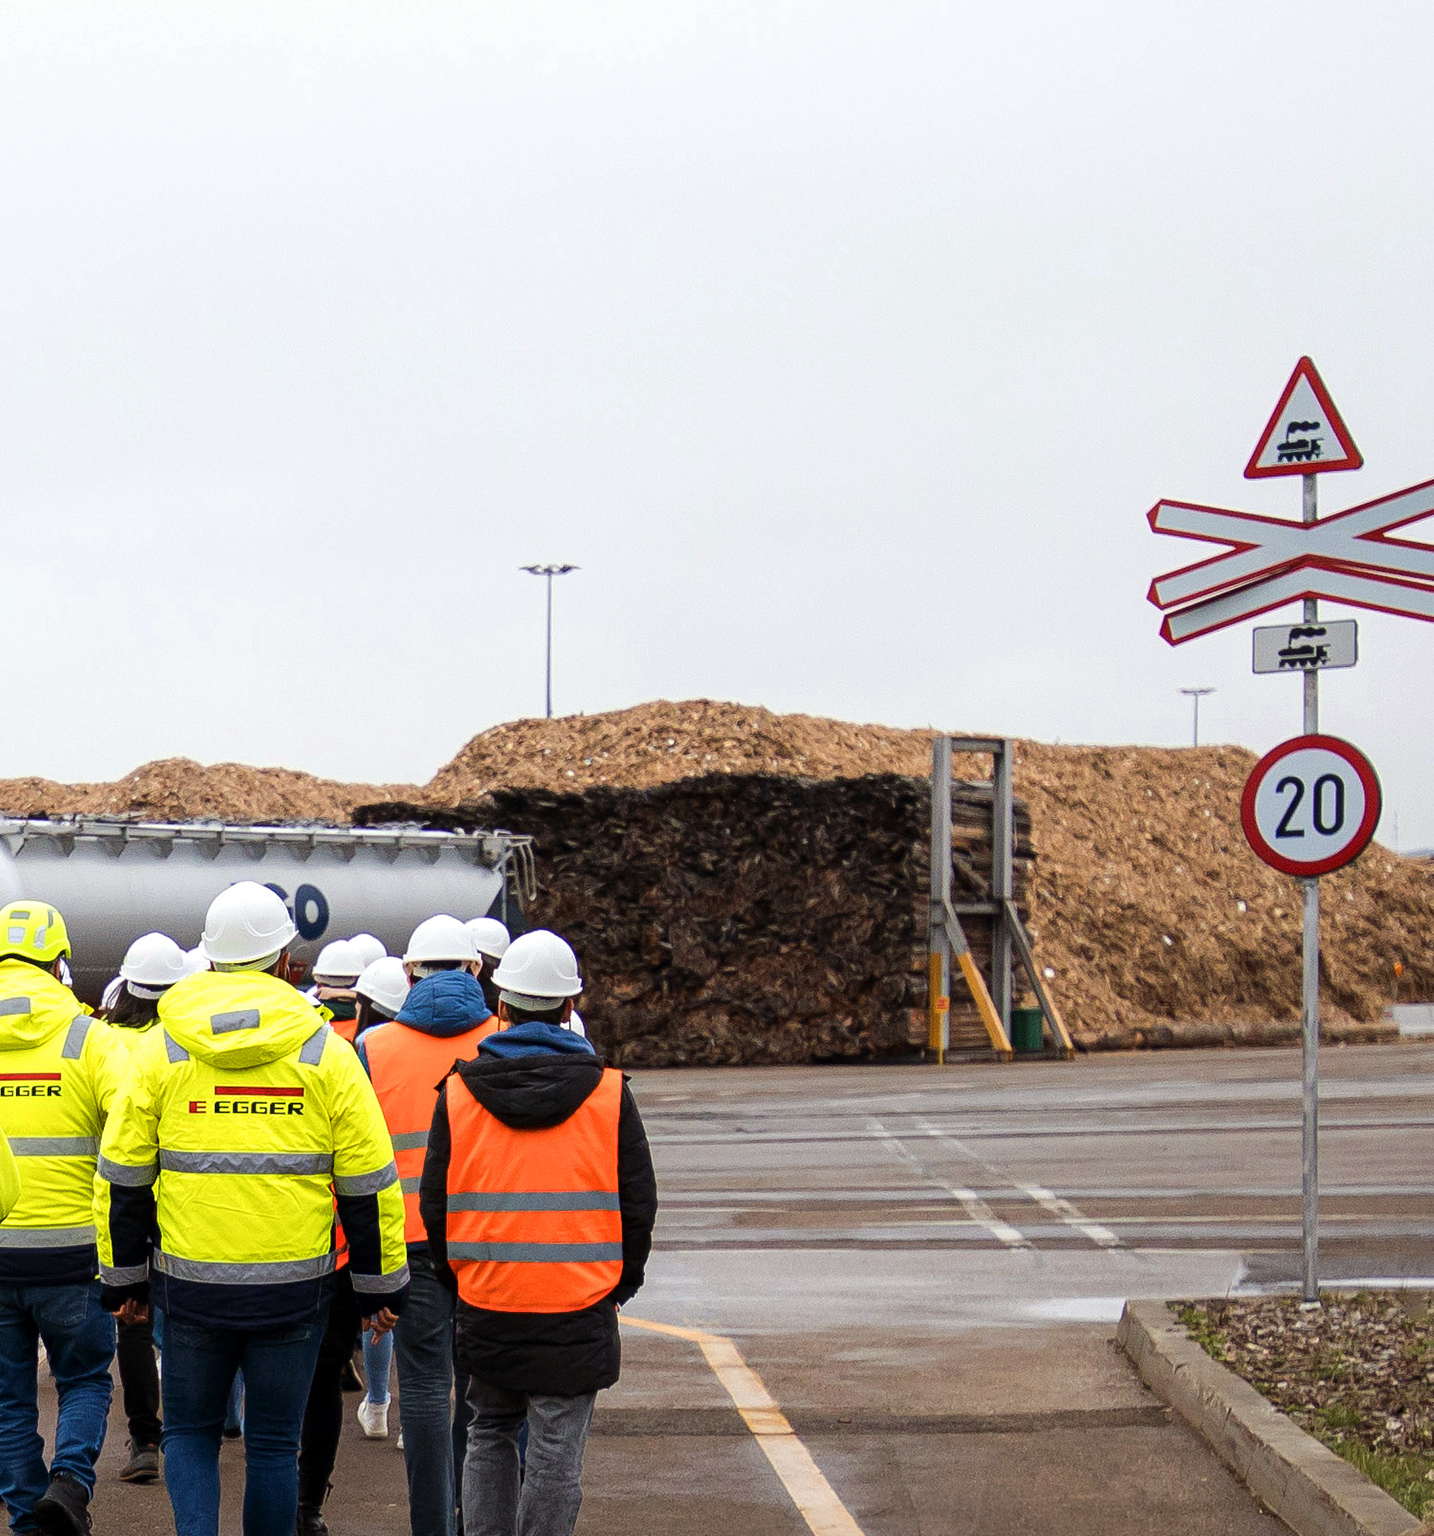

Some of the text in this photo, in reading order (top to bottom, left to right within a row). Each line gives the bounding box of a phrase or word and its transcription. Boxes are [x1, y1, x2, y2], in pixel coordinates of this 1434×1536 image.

[1275, 773, 1345, 839] 20
[189, 1101, 304, 1115] E EGGER
